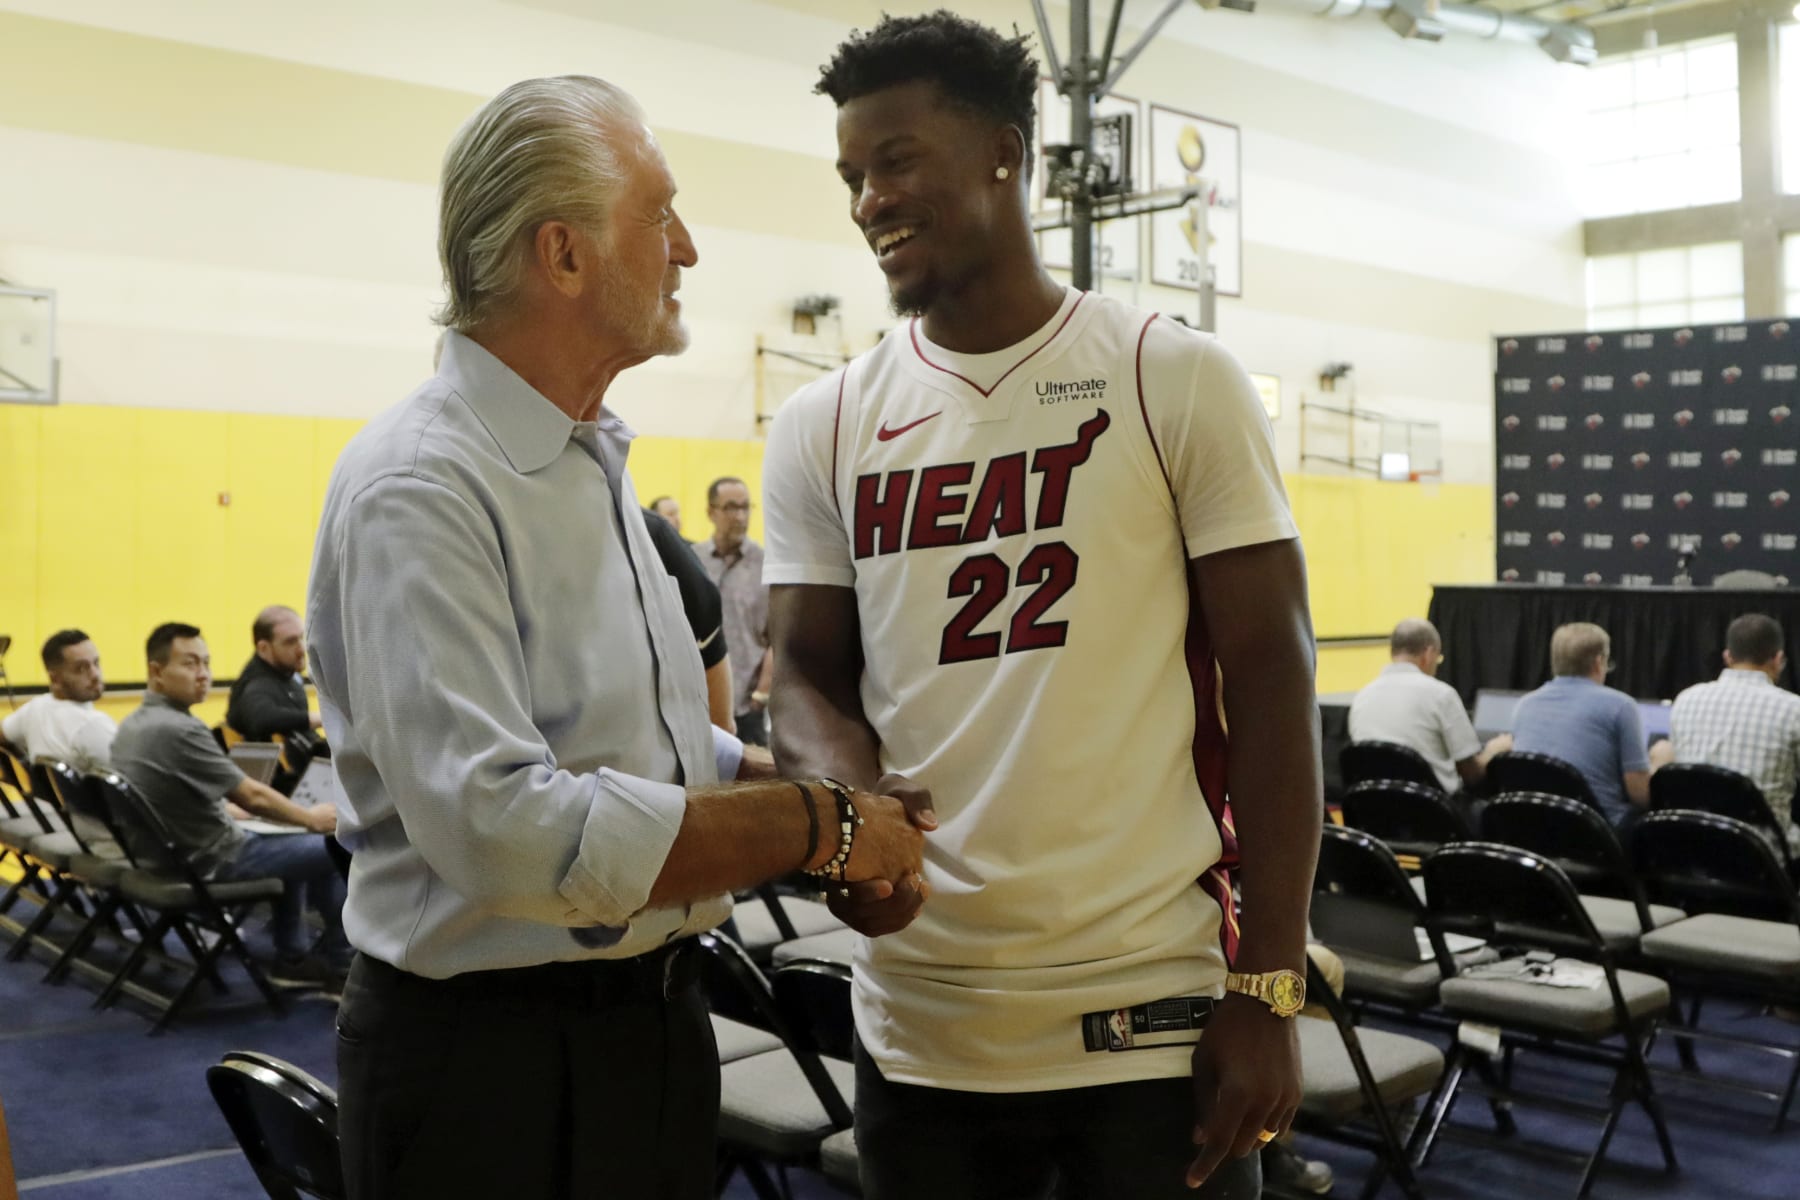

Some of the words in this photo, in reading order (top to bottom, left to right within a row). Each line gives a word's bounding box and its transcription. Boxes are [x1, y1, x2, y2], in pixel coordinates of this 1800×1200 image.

[1035, 378, 1107, 396] Ultimate
[1039, 391, 1104, 405] SOFTWARE
[854, 408, 1111, 560] HEAT
[938, 541, 1079, 665] 22
